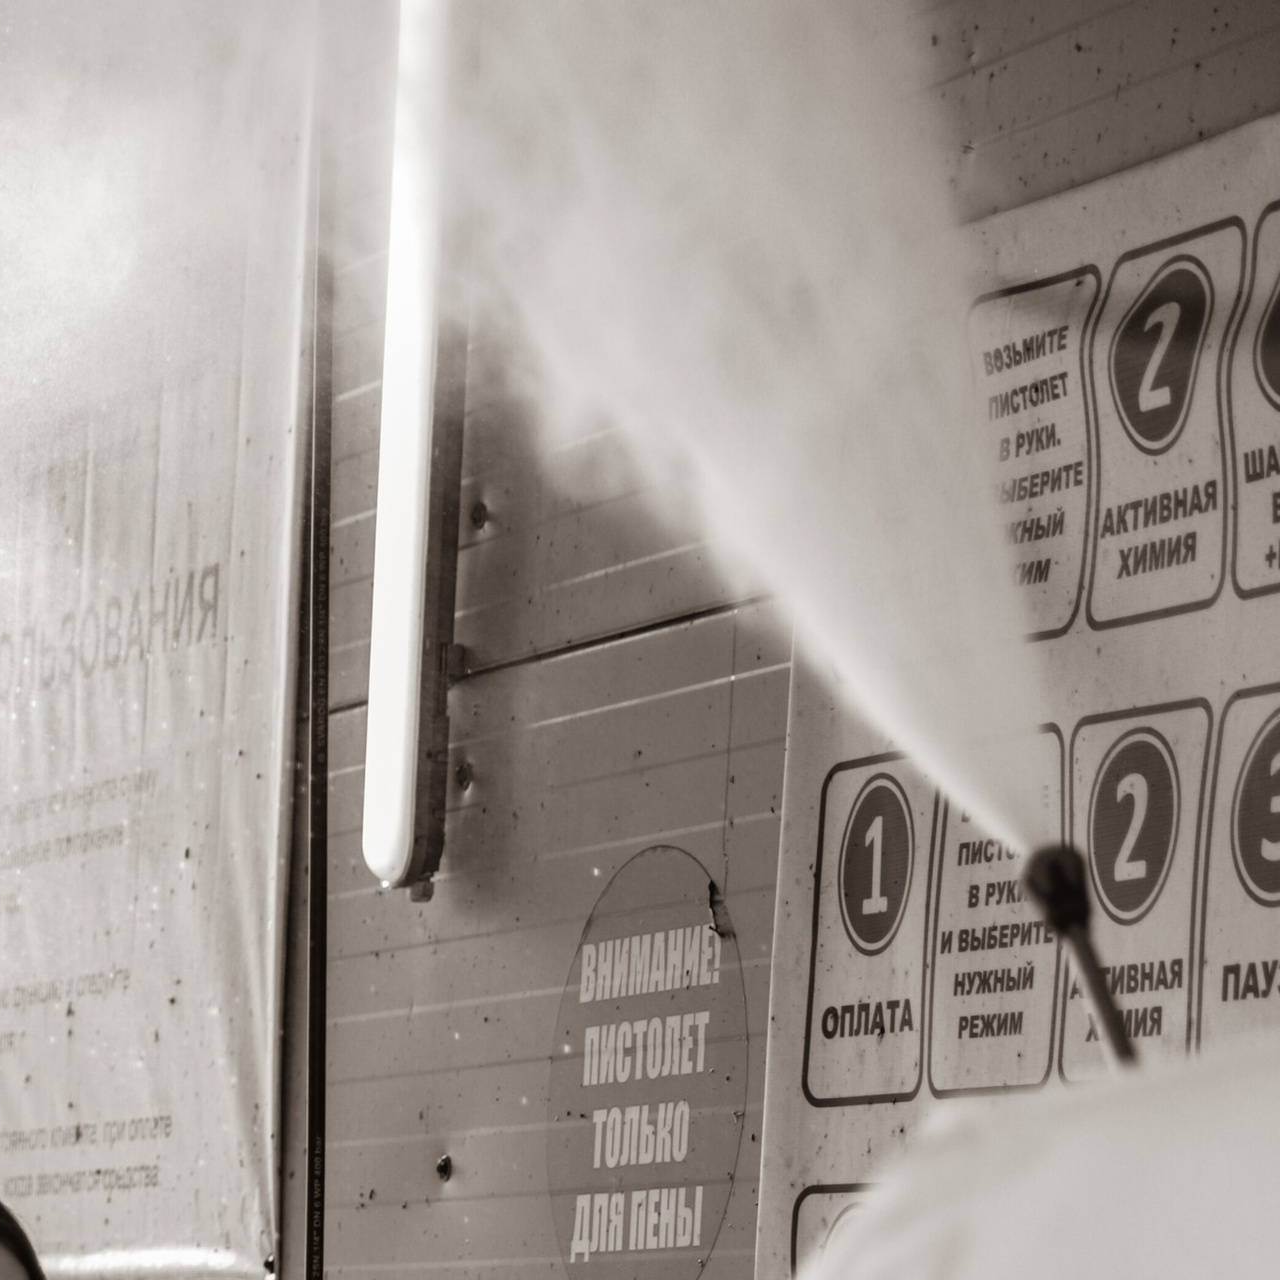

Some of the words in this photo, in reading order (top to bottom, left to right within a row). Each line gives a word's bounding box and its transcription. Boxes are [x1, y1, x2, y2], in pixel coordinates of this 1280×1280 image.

[983, 325, 1069, 376] ВОЗЬМИТЕ
[1138, 301, 1181, 413] 2
[988, 371, 1068, 420] ПИСТОЛЕТ
[1000, 437, 1011, 462] В
[1015, 423, 1061, 458] РУКИ.
[999, 460, 1084, 504] ЫБЕРИТЕ
[1100, 479, 1218, 540] АКТИВНАЯ
[1116, 531, 1197, 580] ХИМИЯ
[1114, 773, 1148, 882] 2
[862, 815, 888, 915] 1
[967, 884, 980, 909] В
[984, 880, 1028, 907] РУК
[940, 930, 954, 955] И
[958, 920, 1055, 953] ВЫБЕРИТЕ
[579, 923, 721, 1004] ВНИМАНИЕ!
[953, 960, 1035, 997] НУЖНЫЙ
[1070, 958, 1184, 1000] АТИВНАЯ
[1222, 959, 1280, 1002] ПАУ
[821, 998, 914, 1041] ОПЛАТА
[957, 1010, 1024, 1040] РЕЖИМ
[1085, 1006, 1163, 1042] ХМИЯ
[582, 1011, 710, 1086] ПИСТОЛЕТ
[314, 1135, 323, 1154] bar
[592, 1100, 690, 1169] ТОЛЬКО
[314, 1156, 323, 1176] 400
[314, 1179, 322, 1198] WP
[313, 1210, 322, 1227] DN
[570, 1193, 624, 1263] ДЛЯ
[628, 1186, 703, 1251] ПЕНЫ
